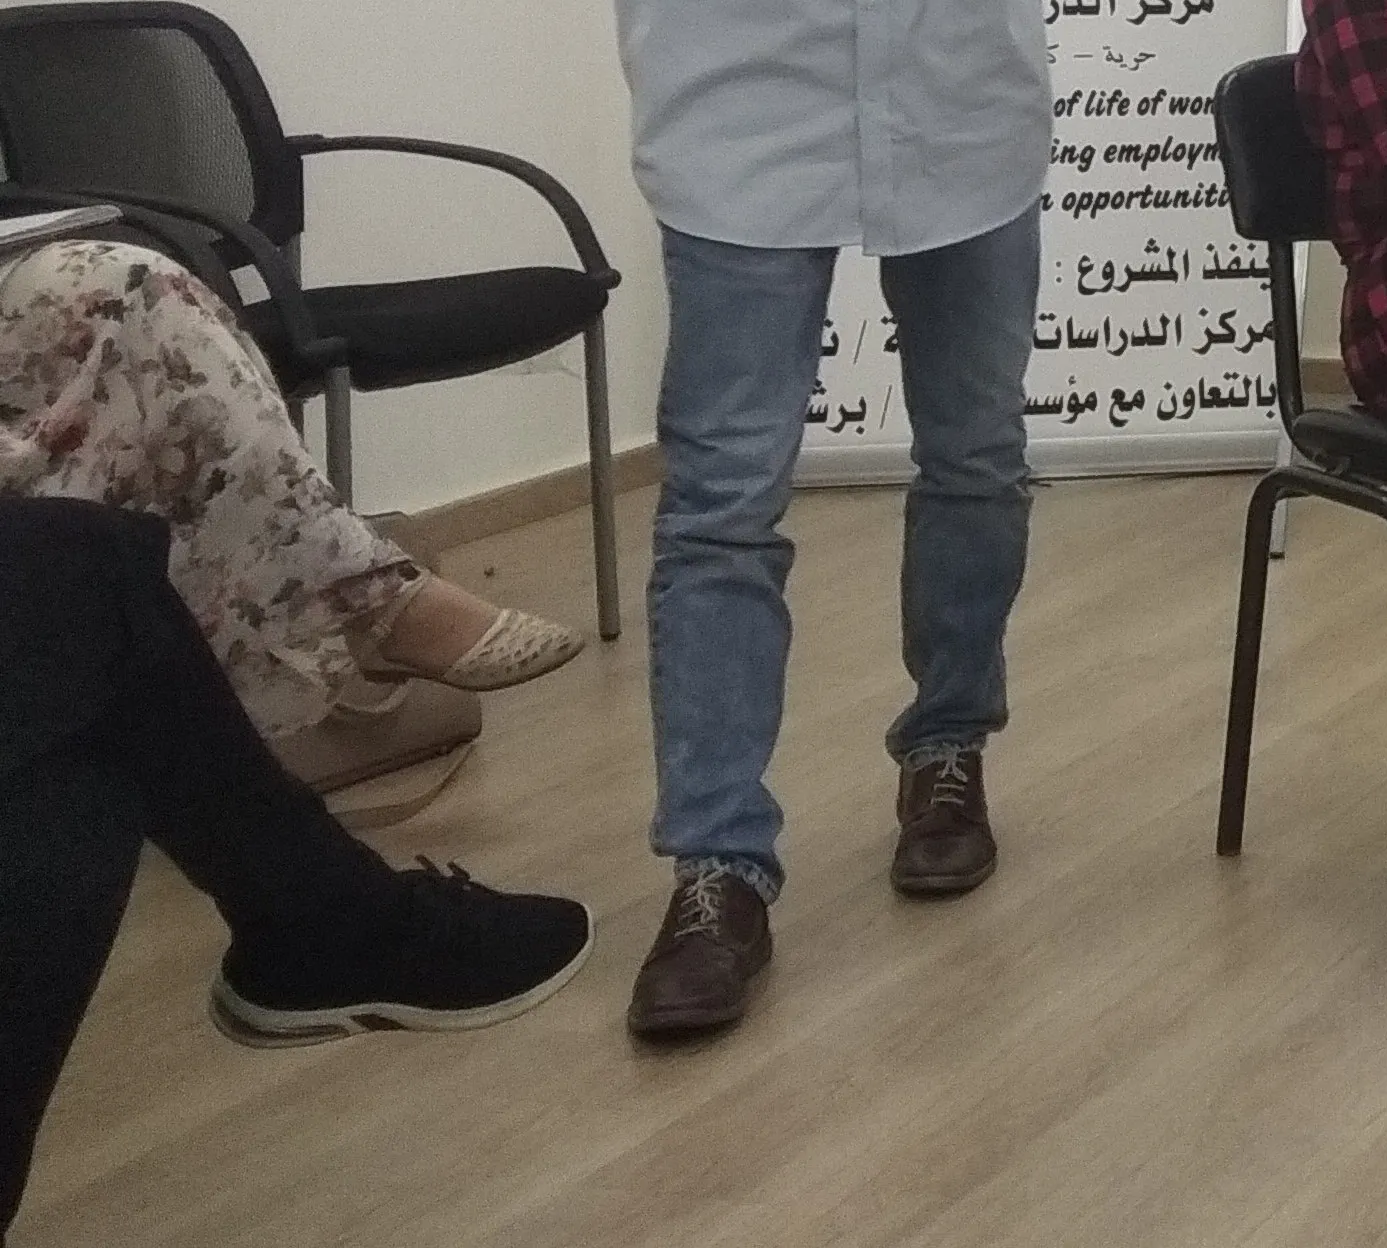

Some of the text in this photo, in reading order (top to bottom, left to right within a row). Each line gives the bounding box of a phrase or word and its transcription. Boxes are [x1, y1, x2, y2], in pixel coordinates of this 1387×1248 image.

[1103, 45, 1157, 72] حرية
[1054, 89, 1083, 117] of
[1084, 89, 1131, 117] life
[1136, 88, 1168, 116] of
[1076, 237, 1190, 296] المشروع
[1033, 312, 1182, 356] الدراسات
[1108, 387, 1146, 428] مع
[1156, 371, 1277, 421] بالتعاون
